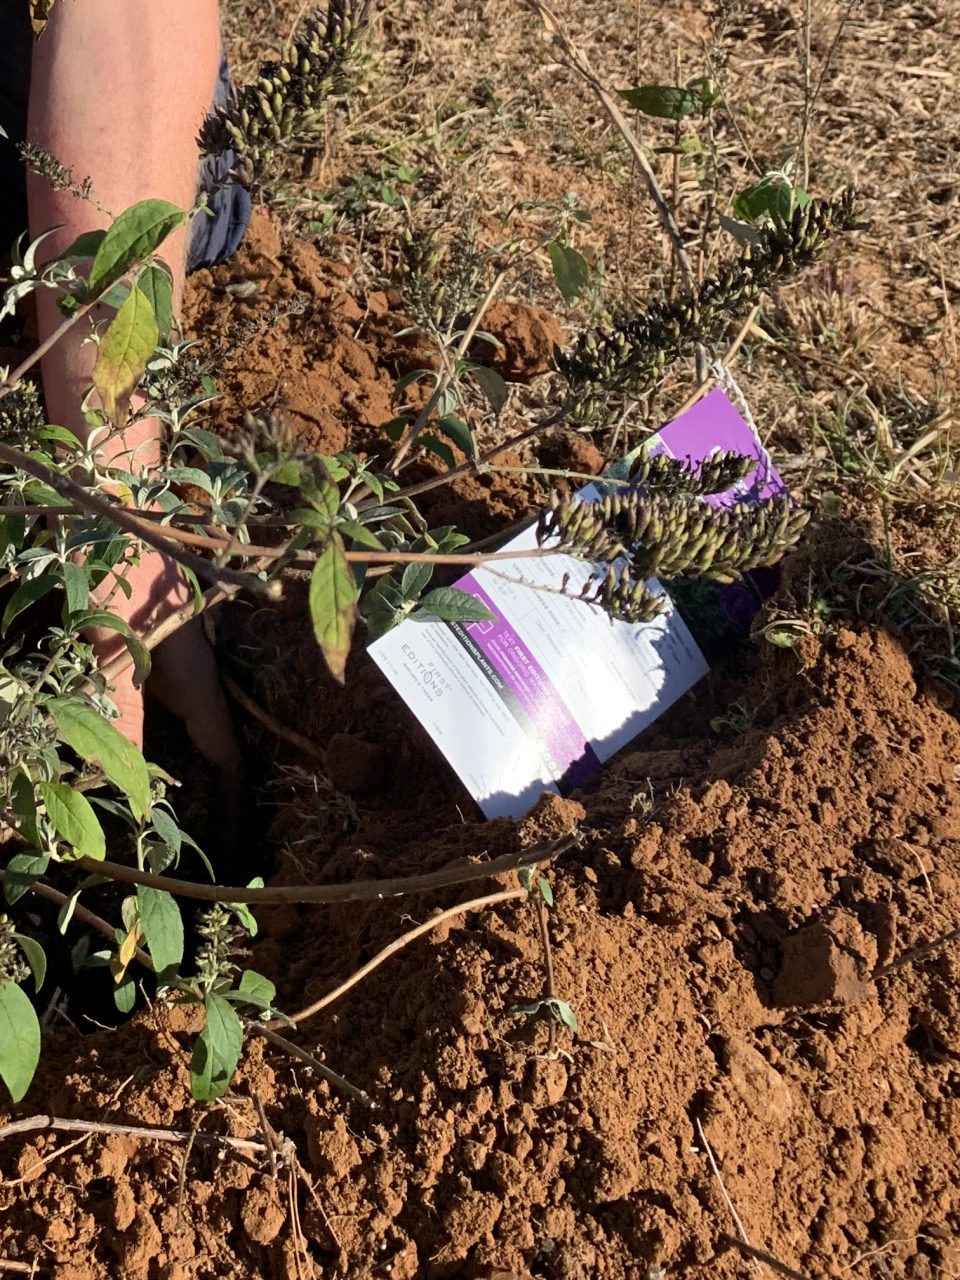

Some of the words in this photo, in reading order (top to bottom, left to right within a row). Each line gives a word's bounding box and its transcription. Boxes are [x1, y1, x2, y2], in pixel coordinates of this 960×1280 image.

[400, 643, 444, 697] EDITIONS
[449, 619, 504, 689] STEDITIONSPLANTS.COM
[512, 645, 530, 665] FIRST
[426, 661, 450, 689] FIRST
